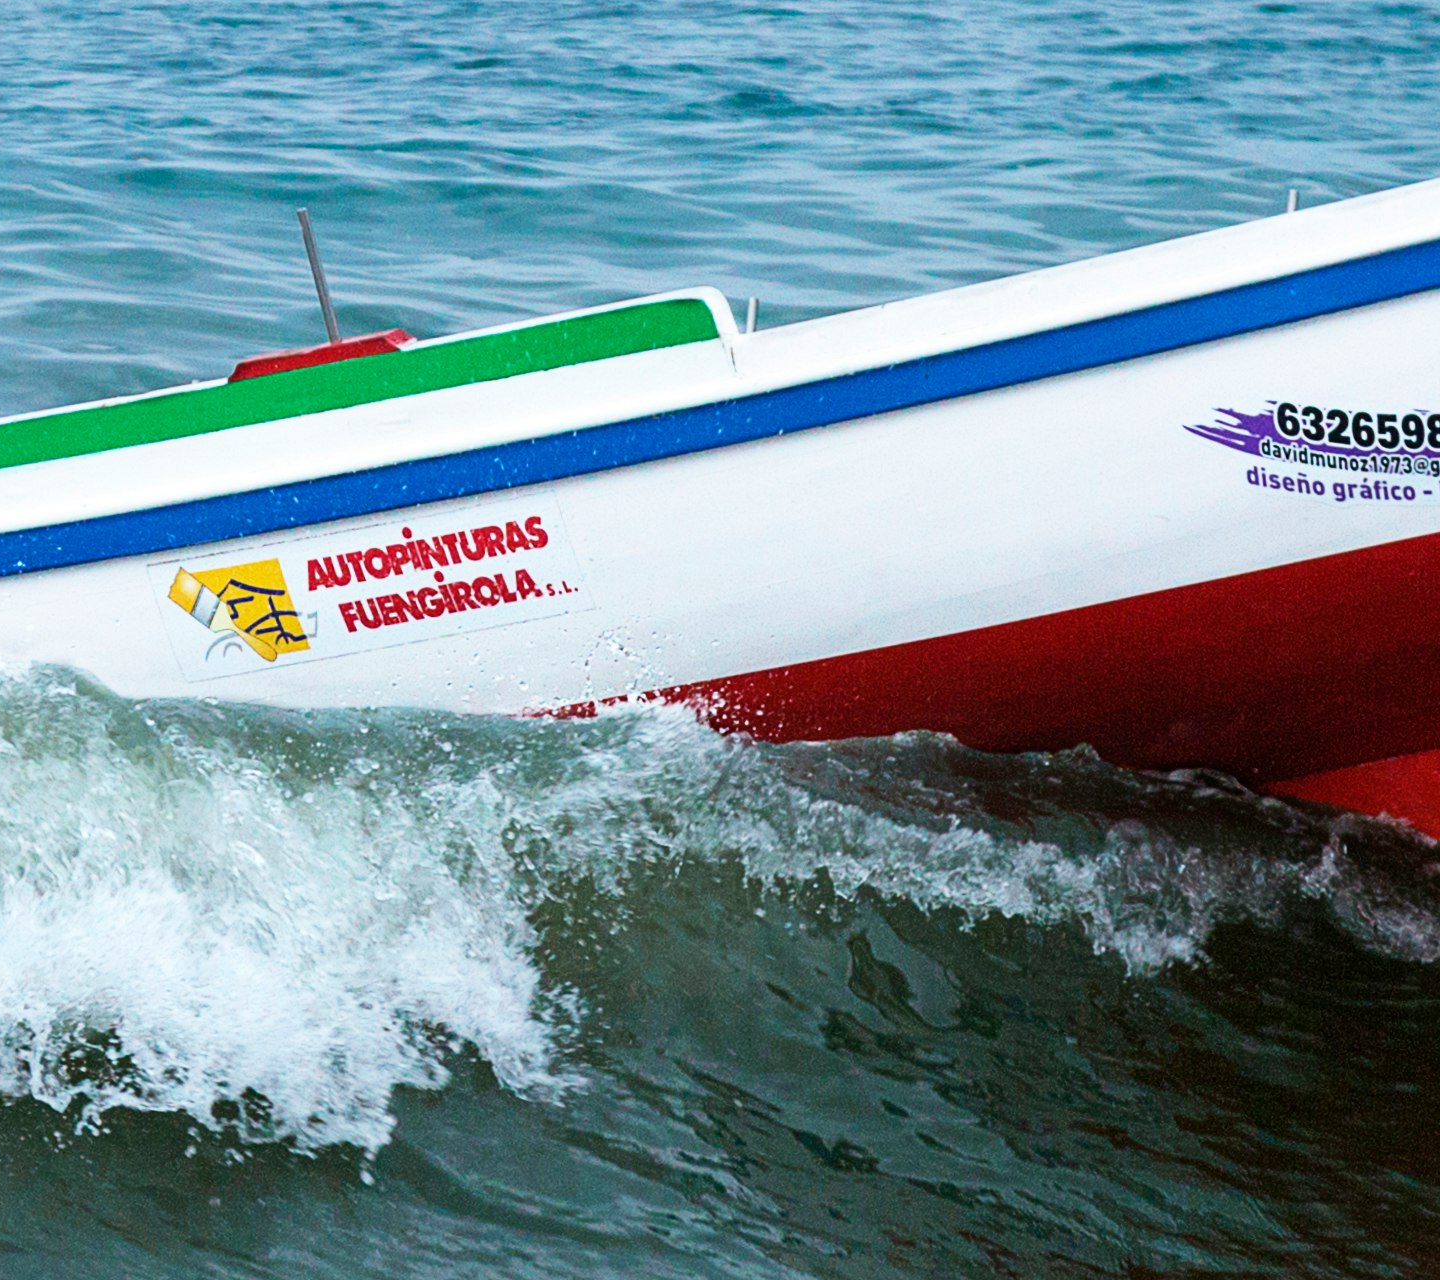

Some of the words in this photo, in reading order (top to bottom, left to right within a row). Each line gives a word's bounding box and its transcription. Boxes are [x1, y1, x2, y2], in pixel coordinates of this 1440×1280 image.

[1246, 466, 1326, 496] diseño
[1333, 478, 1416, 502] gráfico
[307, 516, 549, 591] AUTOPINTURAS
[338, 569, 543, 632] FUENGIROLA
